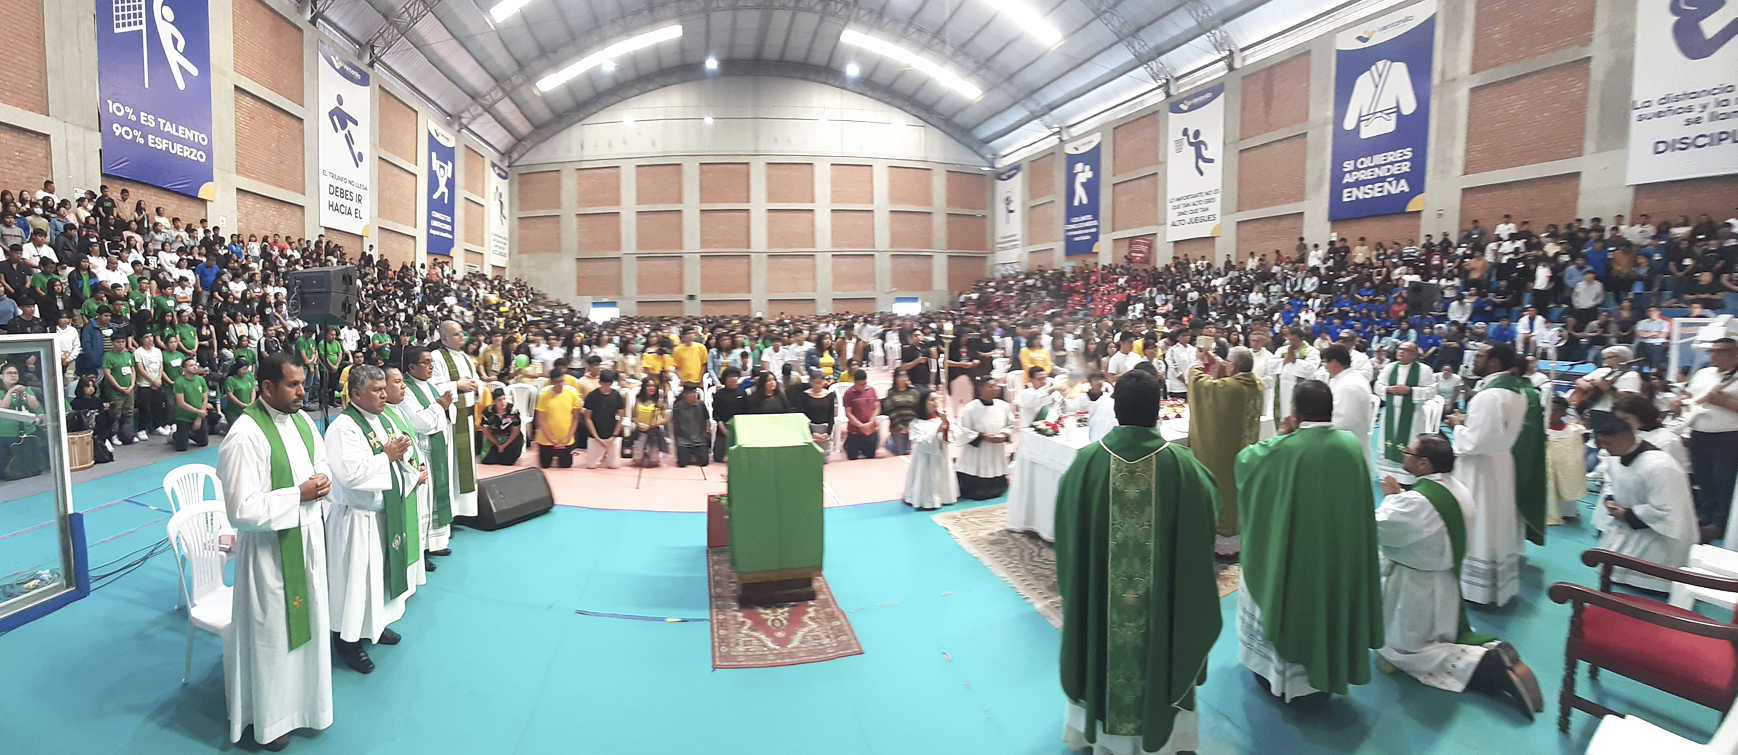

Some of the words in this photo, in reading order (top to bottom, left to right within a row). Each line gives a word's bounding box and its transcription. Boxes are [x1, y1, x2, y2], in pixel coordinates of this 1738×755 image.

[1658, 83, 1735, 106] distancia
[106, 99, 137, 122] 10%
[140, 111, 156, 128] ES
[157, 117, 209, 146] TALENTO
[1637, 104, 1695, 122] sueños
[112, 122, 145, 145] 90%
[147, 133, 207, 163] ESFUERZO
[1342, 159, 1356, 172] SI
[1356, 147, 1414, 169] QUIERES
[1341, 161, 1412, 184] APRENDER
[328, 183, 354, 202] DEBES
[355, 192, 363, 205] IR
[1341, 177, 1411, 202] ENSEÑA
[327, 199, 353, 217] HACIA
[354, 207, 363, 220] EL
